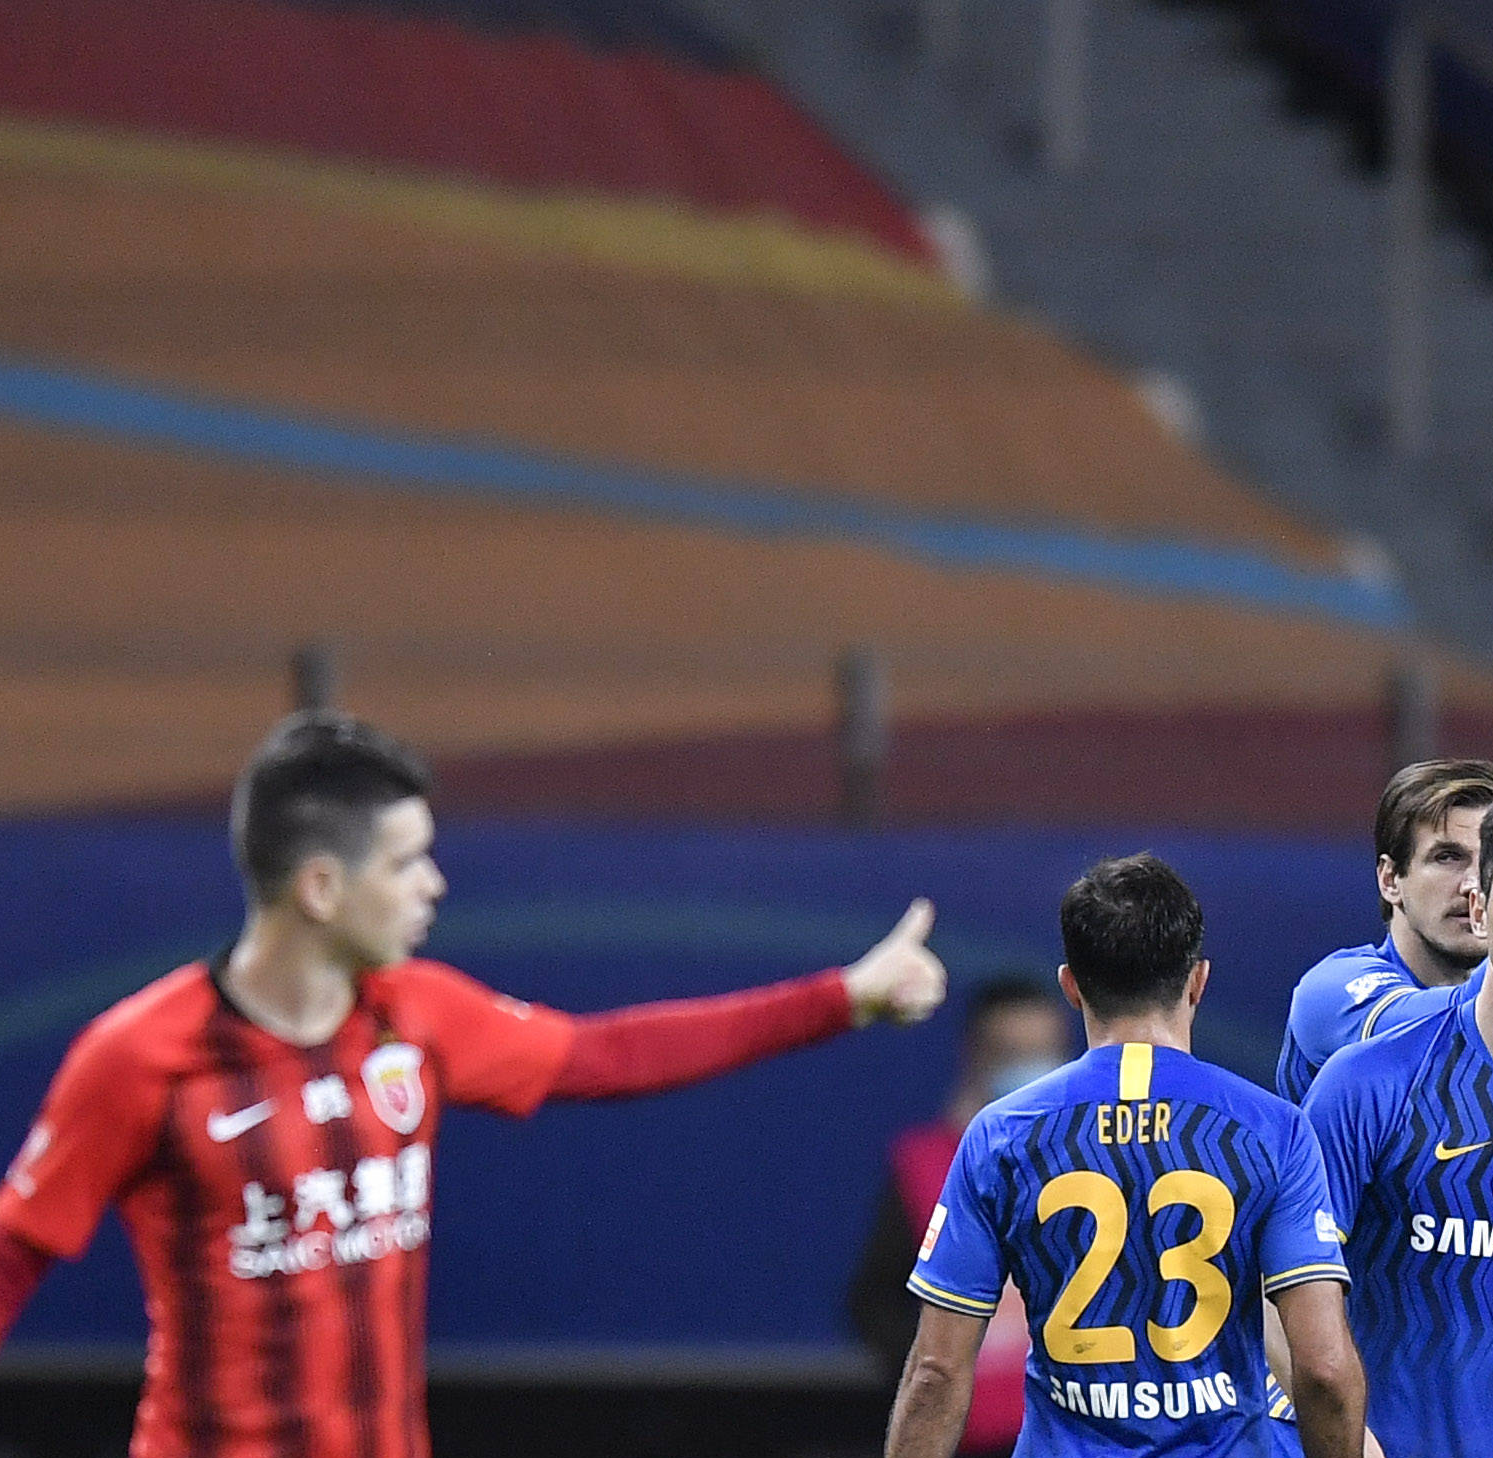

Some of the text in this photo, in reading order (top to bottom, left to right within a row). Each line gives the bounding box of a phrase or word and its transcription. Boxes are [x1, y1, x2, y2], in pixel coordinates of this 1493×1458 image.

[1096, 1102, 1171, 1145] EDER
[1036, 1169, 1236, 1365] 23
[1049, 1372, 1237, 1420] SAMSUNG
